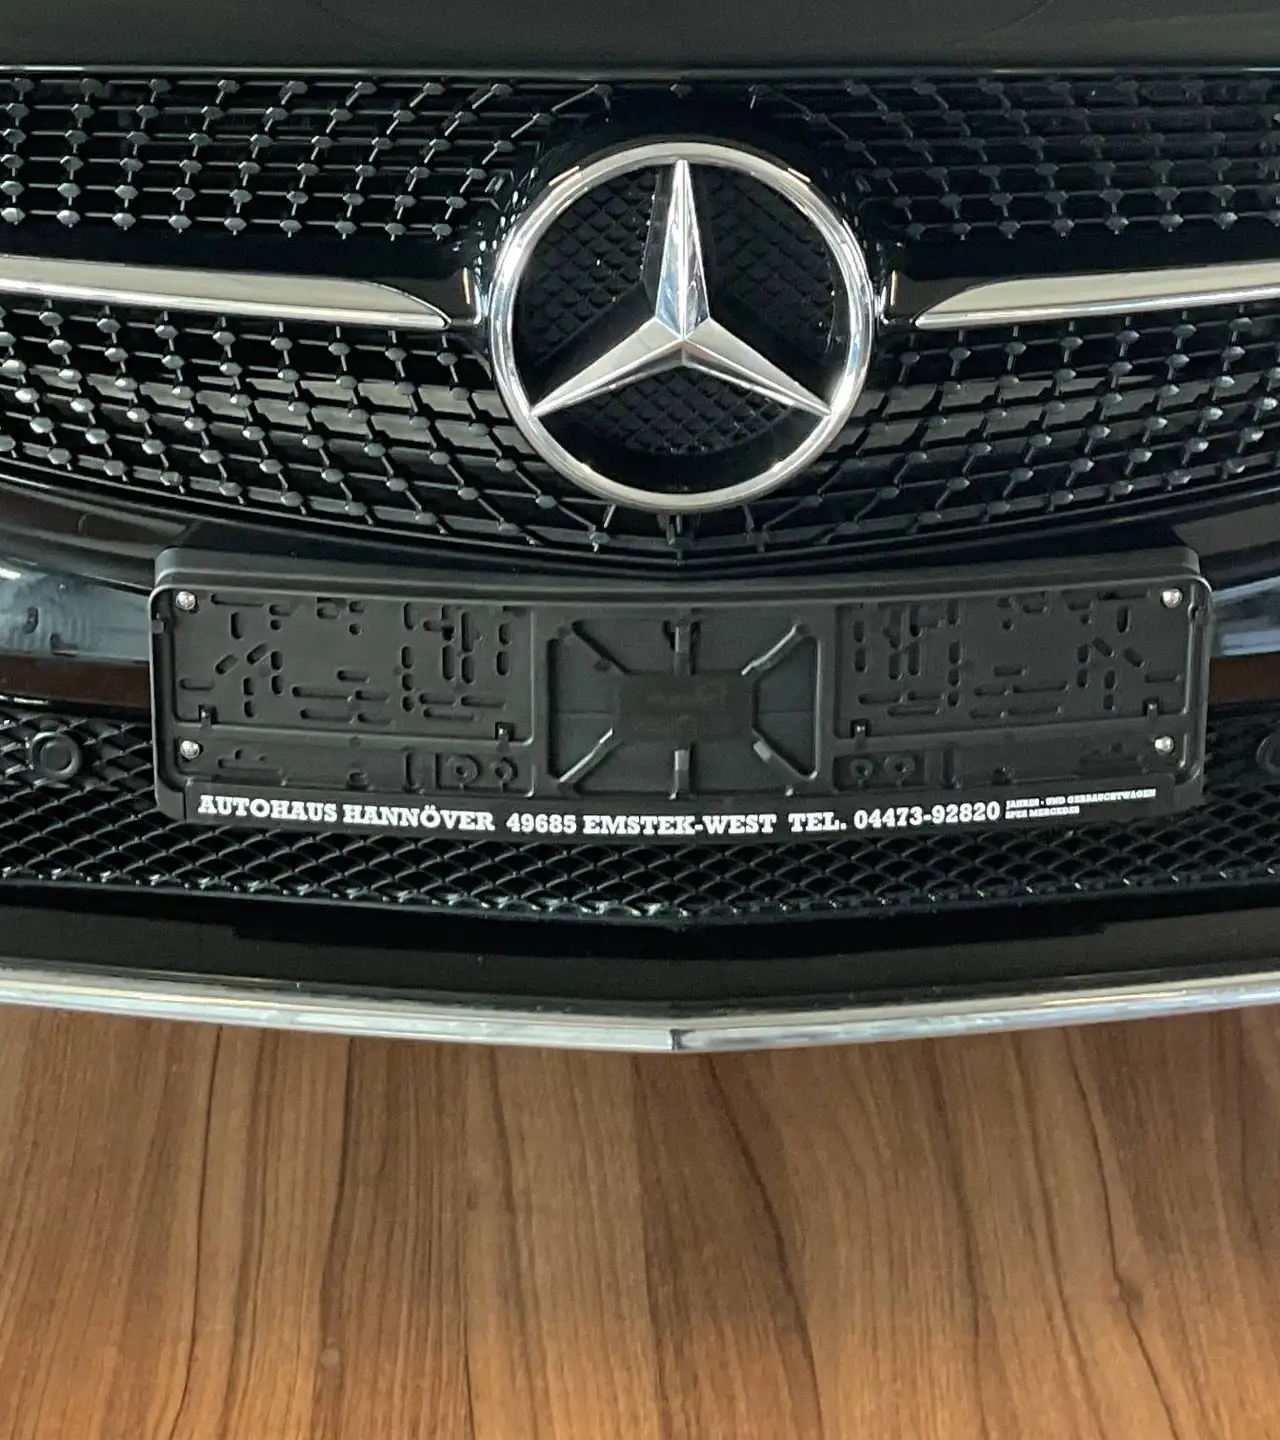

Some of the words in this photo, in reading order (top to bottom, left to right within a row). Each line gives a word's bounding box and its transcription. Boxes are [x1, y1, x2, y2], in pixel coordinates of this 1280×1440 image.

[197, 794, 338, 823] AUTOHAUS
[342, 804, 496, 832] HANNÖVER
[505, 812, 577, 834] 49685
[582, 813, 777, 835] EMSTEK-WEST
[787, 811, 847, 833] TEL.
[853, 800, 1001, 830] 04473-92820
